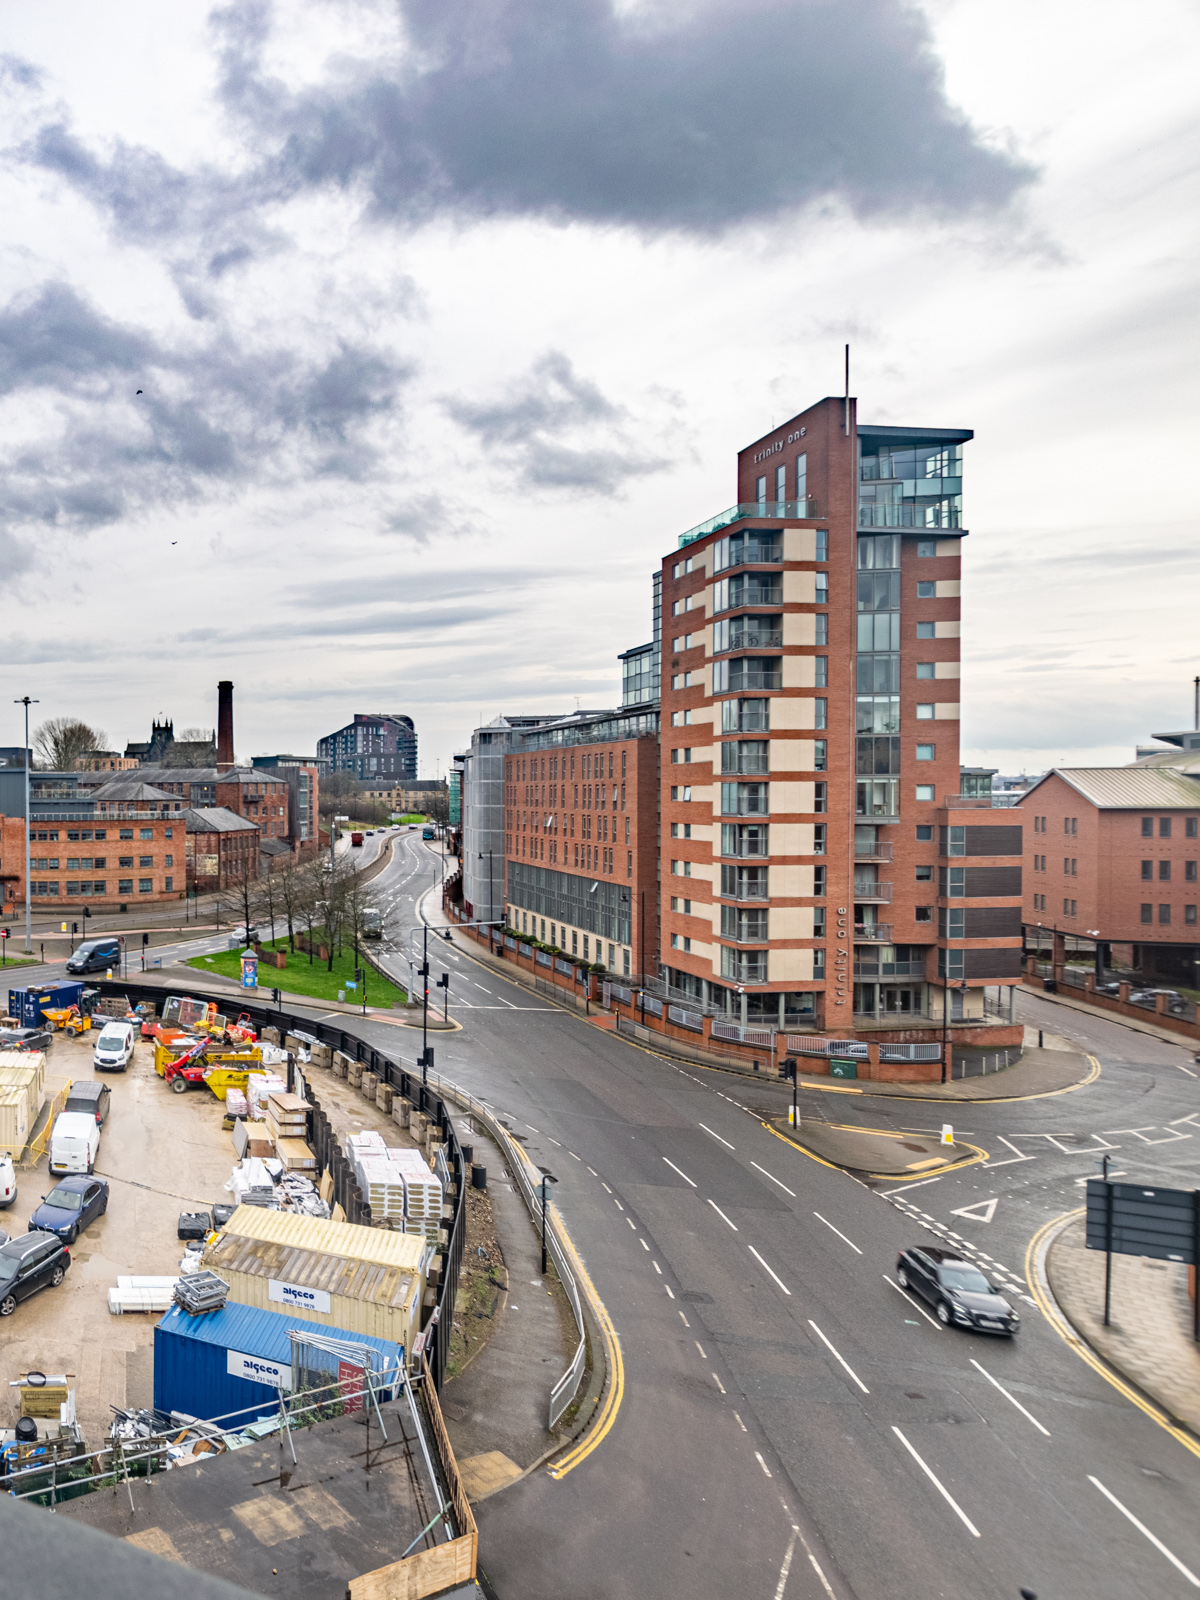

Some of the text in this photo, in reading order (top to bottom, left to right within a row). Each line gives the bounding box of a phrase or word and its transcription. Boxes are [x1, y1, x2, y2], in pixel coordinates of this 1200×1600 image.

[754, 427, 806, 464] trinity one
[835, 907, 848, 1006] trinity one
[282, 1287, 315, 1300] algeco
[243, 1360, 279, 1376] algeco
